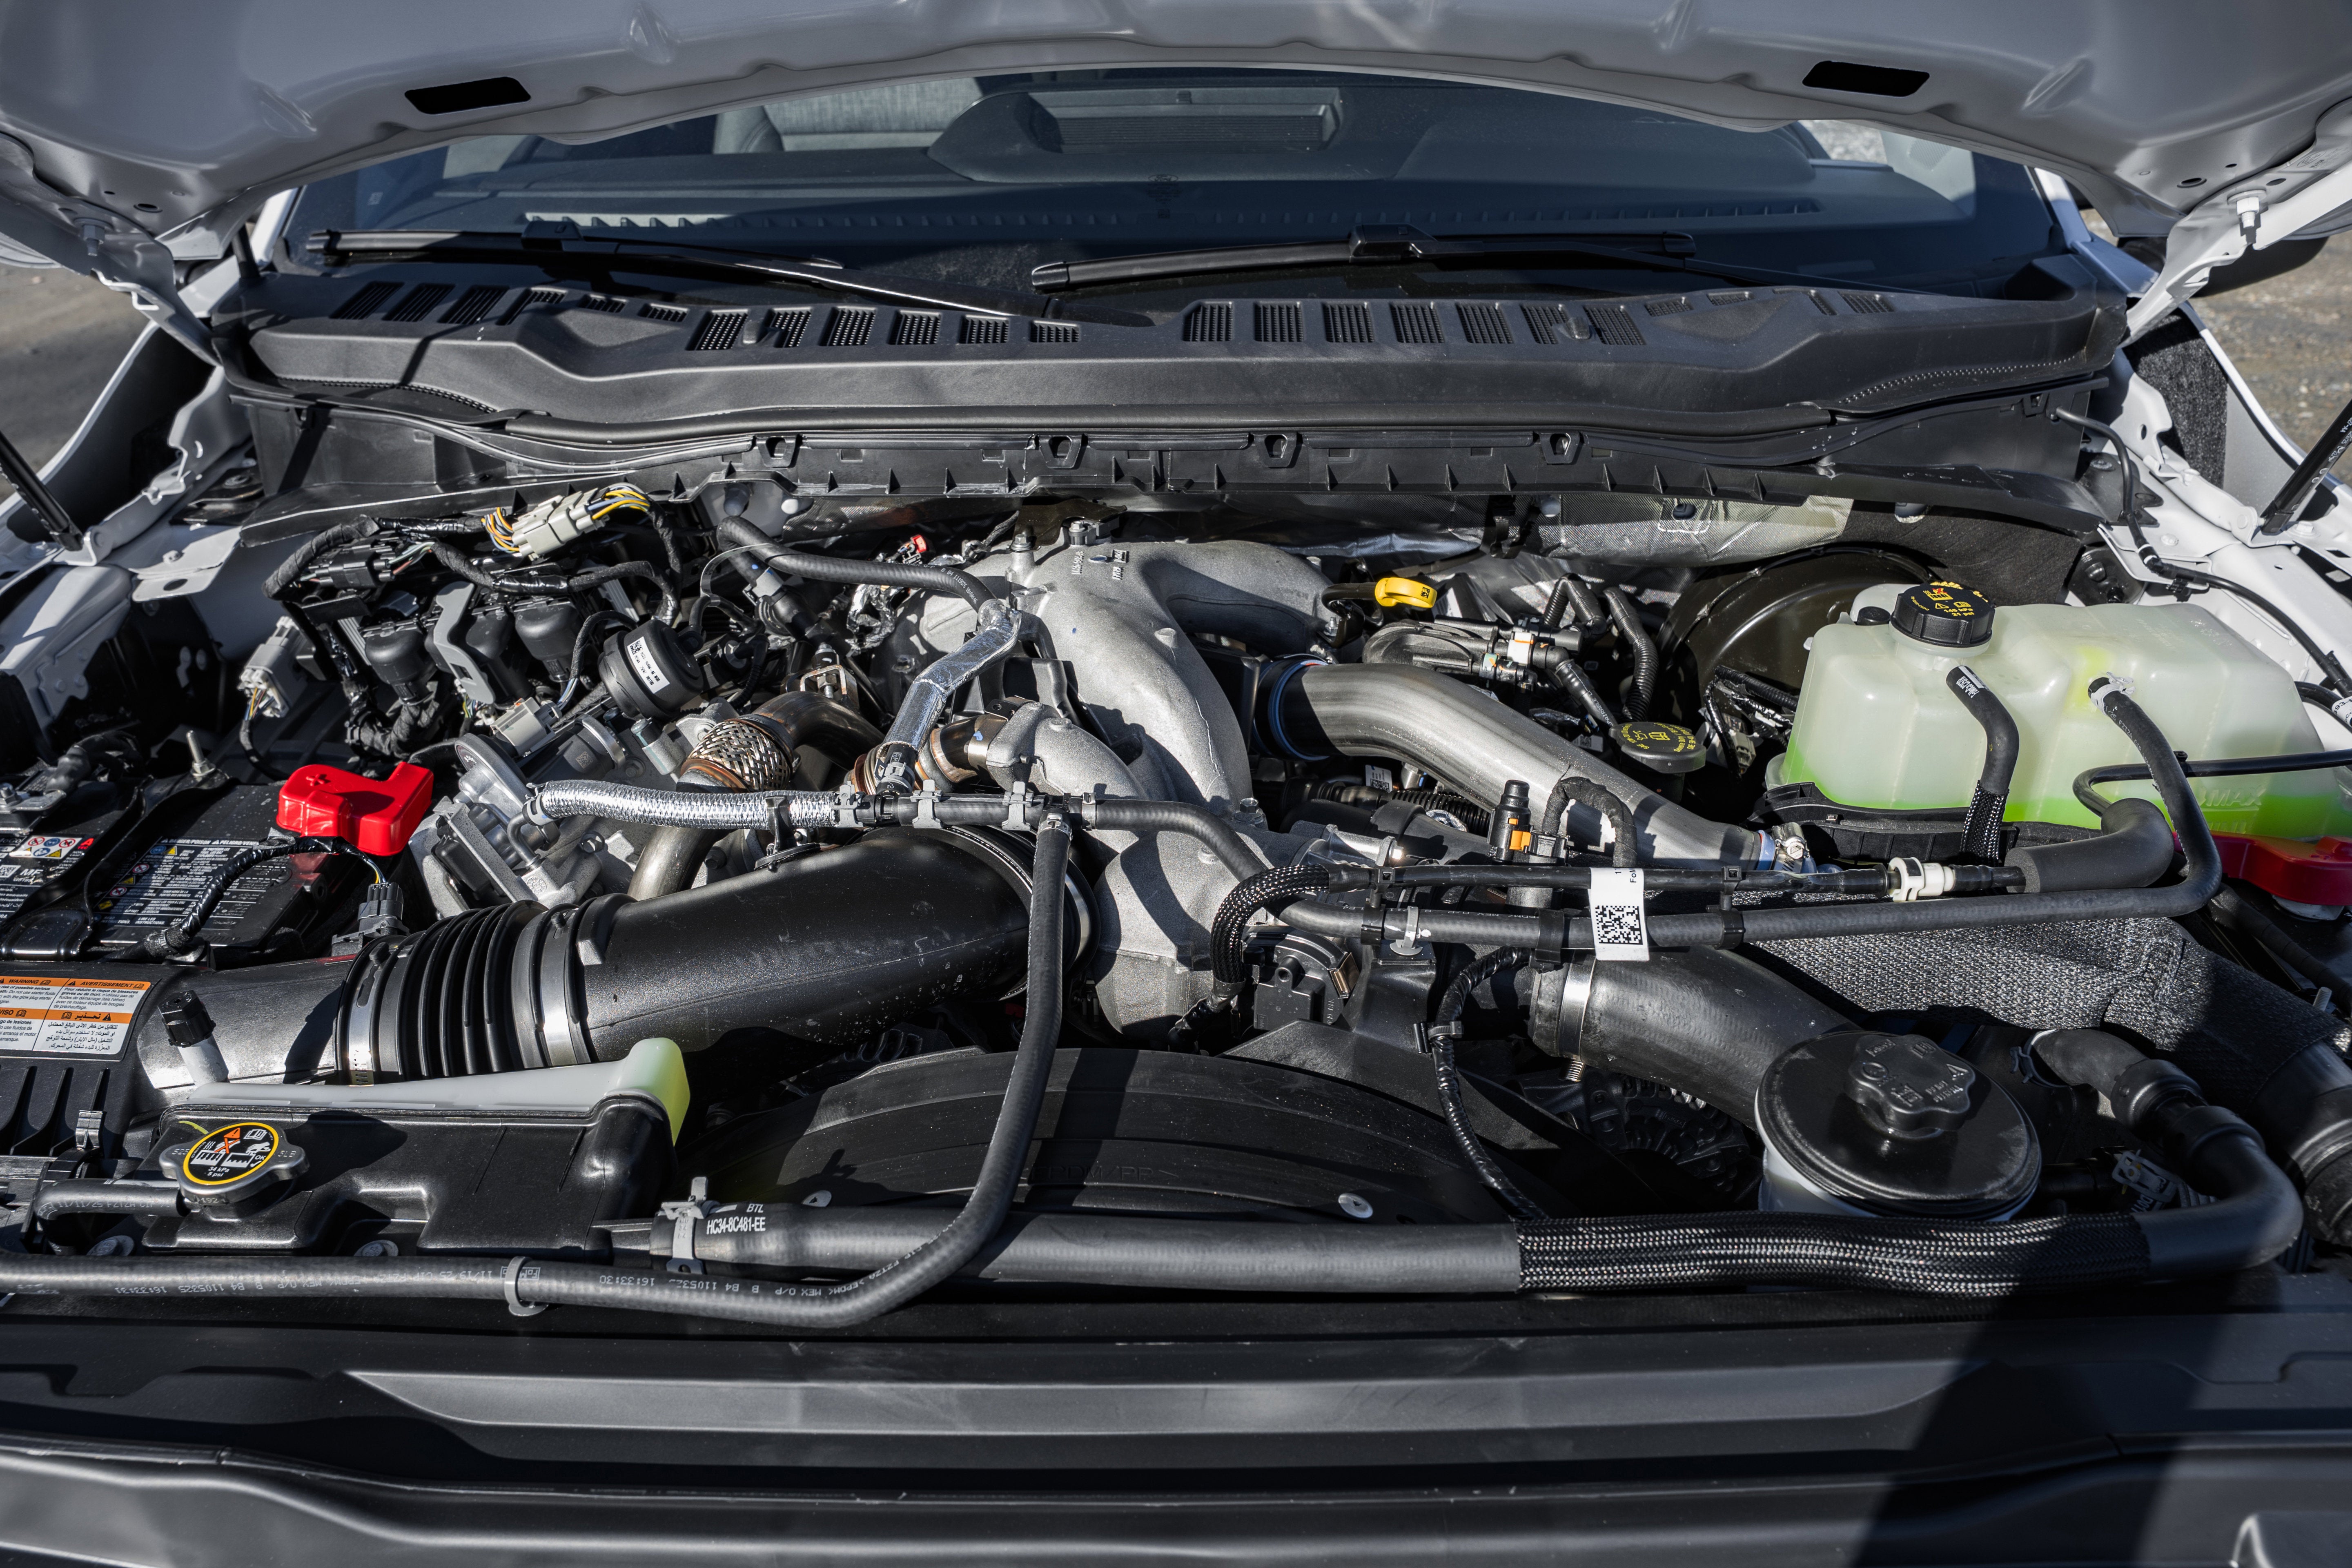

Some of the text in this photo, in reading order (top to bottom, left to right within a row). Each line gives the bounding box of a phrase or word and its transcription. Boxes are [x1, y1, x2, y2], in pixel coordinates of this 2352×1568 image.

[746, 1203, 764, 1213] BTL
[706, 1216, 766, 1234] HC34-8C481-EE
[599, 1275, 655, 1286] 16:33:30
[725, 1282, 739, 1292] B4
[751, 1285, 759, 1293] B
[775, 1286, 796, 1296] O/P
[801, 1287, 822, 1296] MEX
